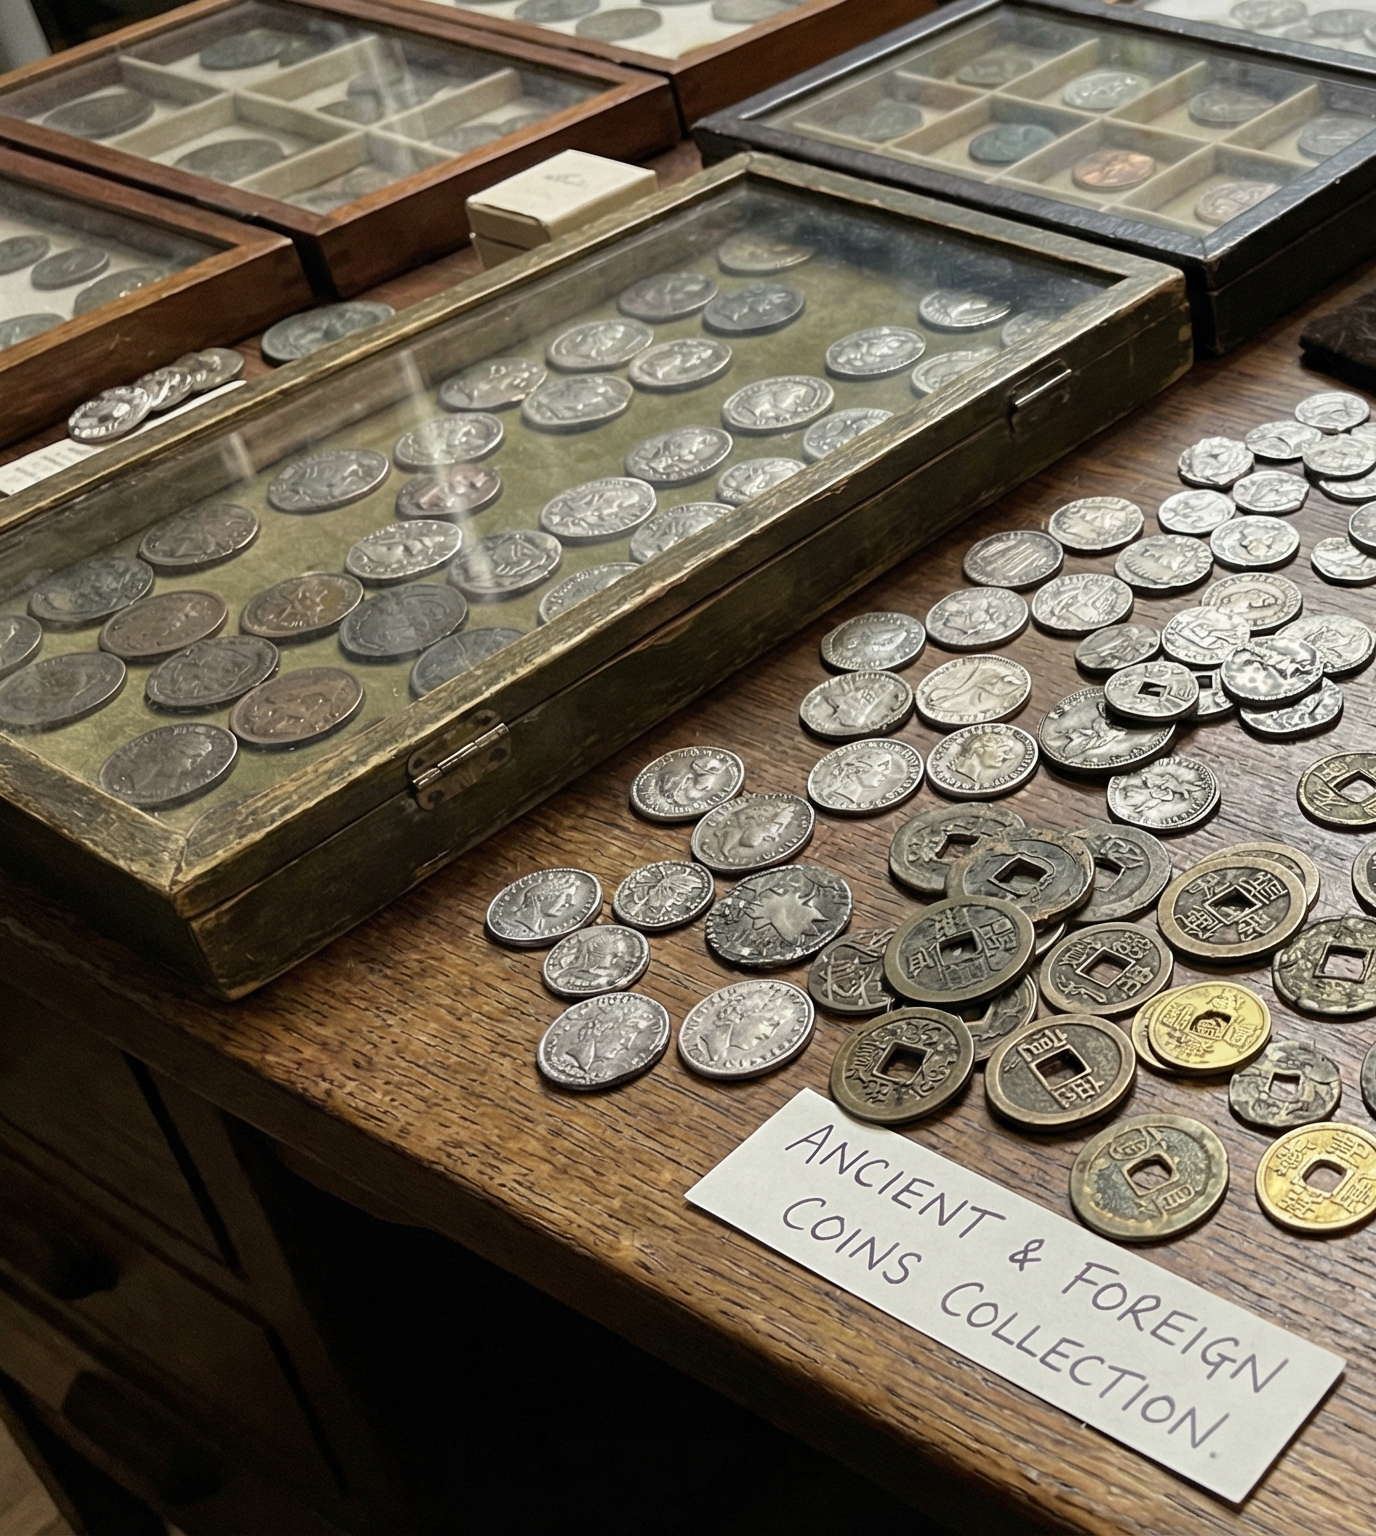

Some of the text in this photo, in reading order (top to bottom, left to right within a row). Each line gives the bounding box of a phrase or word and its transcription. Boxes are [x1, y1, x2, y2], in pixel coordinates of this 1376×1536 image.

[781, 1197, 923, 1285] COINS
[784, 1123, 1006, 1239] ANCIENT
[1008, 1238, 1046, 1272] &
[1061, 1260, 1289, 1394] FOREIGN
